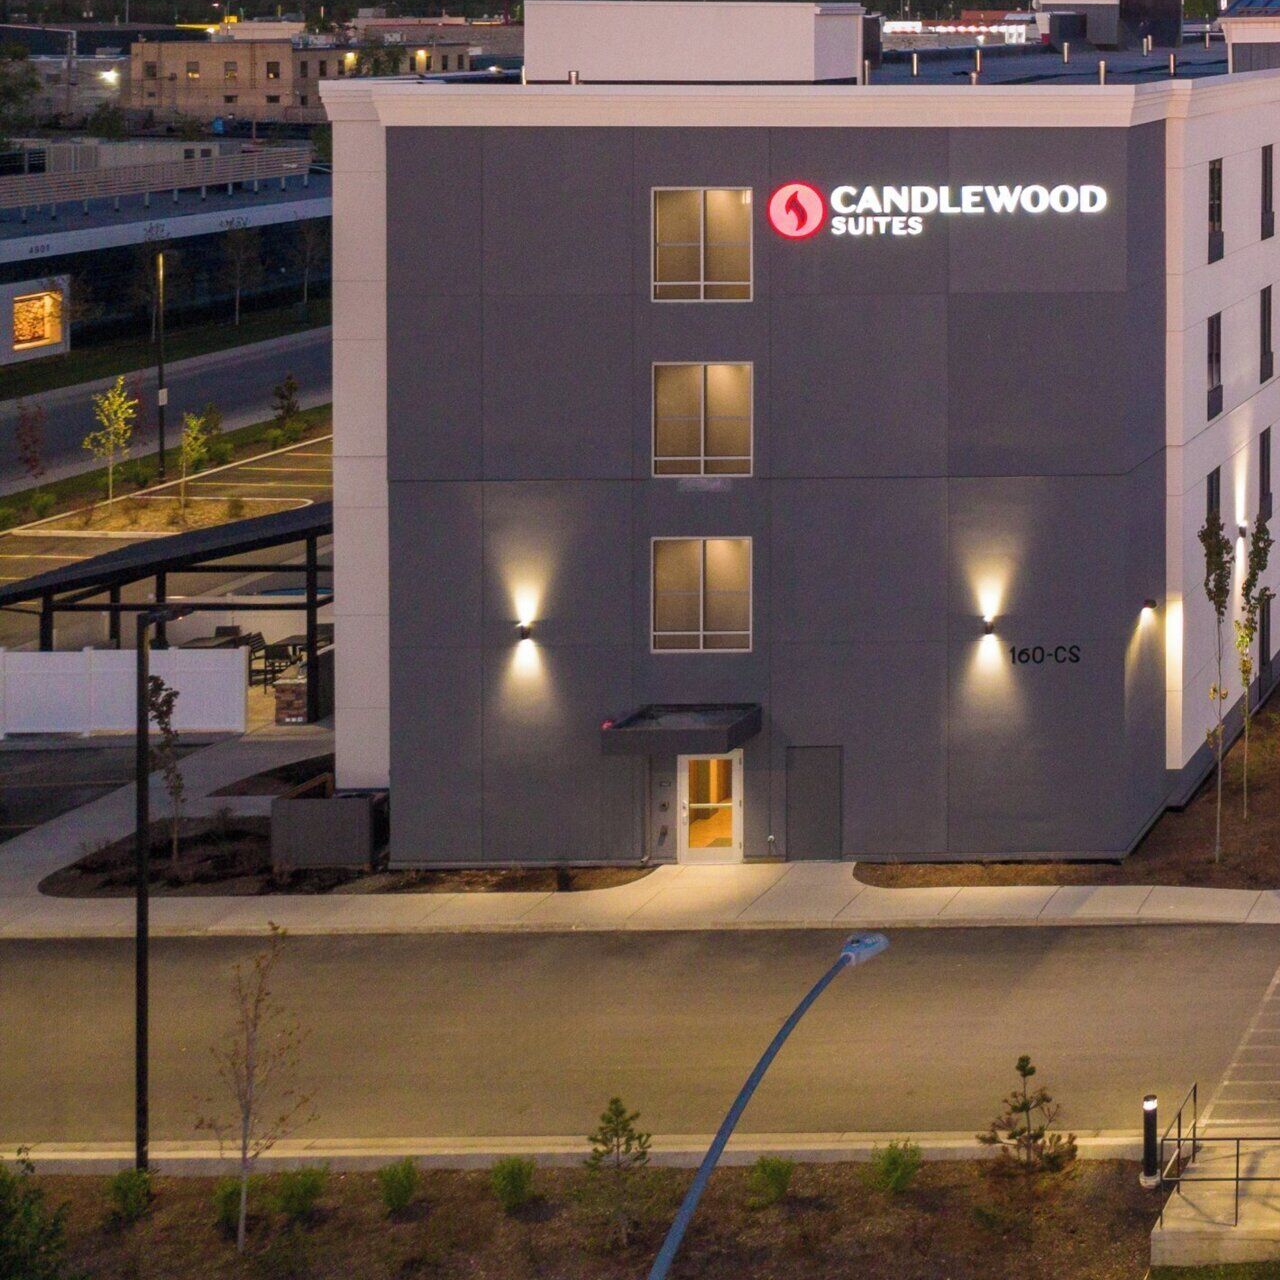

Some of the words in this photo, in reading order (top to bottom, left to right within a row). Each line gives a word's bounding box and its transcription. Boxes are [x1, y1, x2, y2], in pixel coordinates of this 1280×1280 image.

[830, 184, 1107, 213] CANDLEWOOD
[831, 216, 923, 235] SUITES
[1010, 645, 1081, 664] 160-CS
